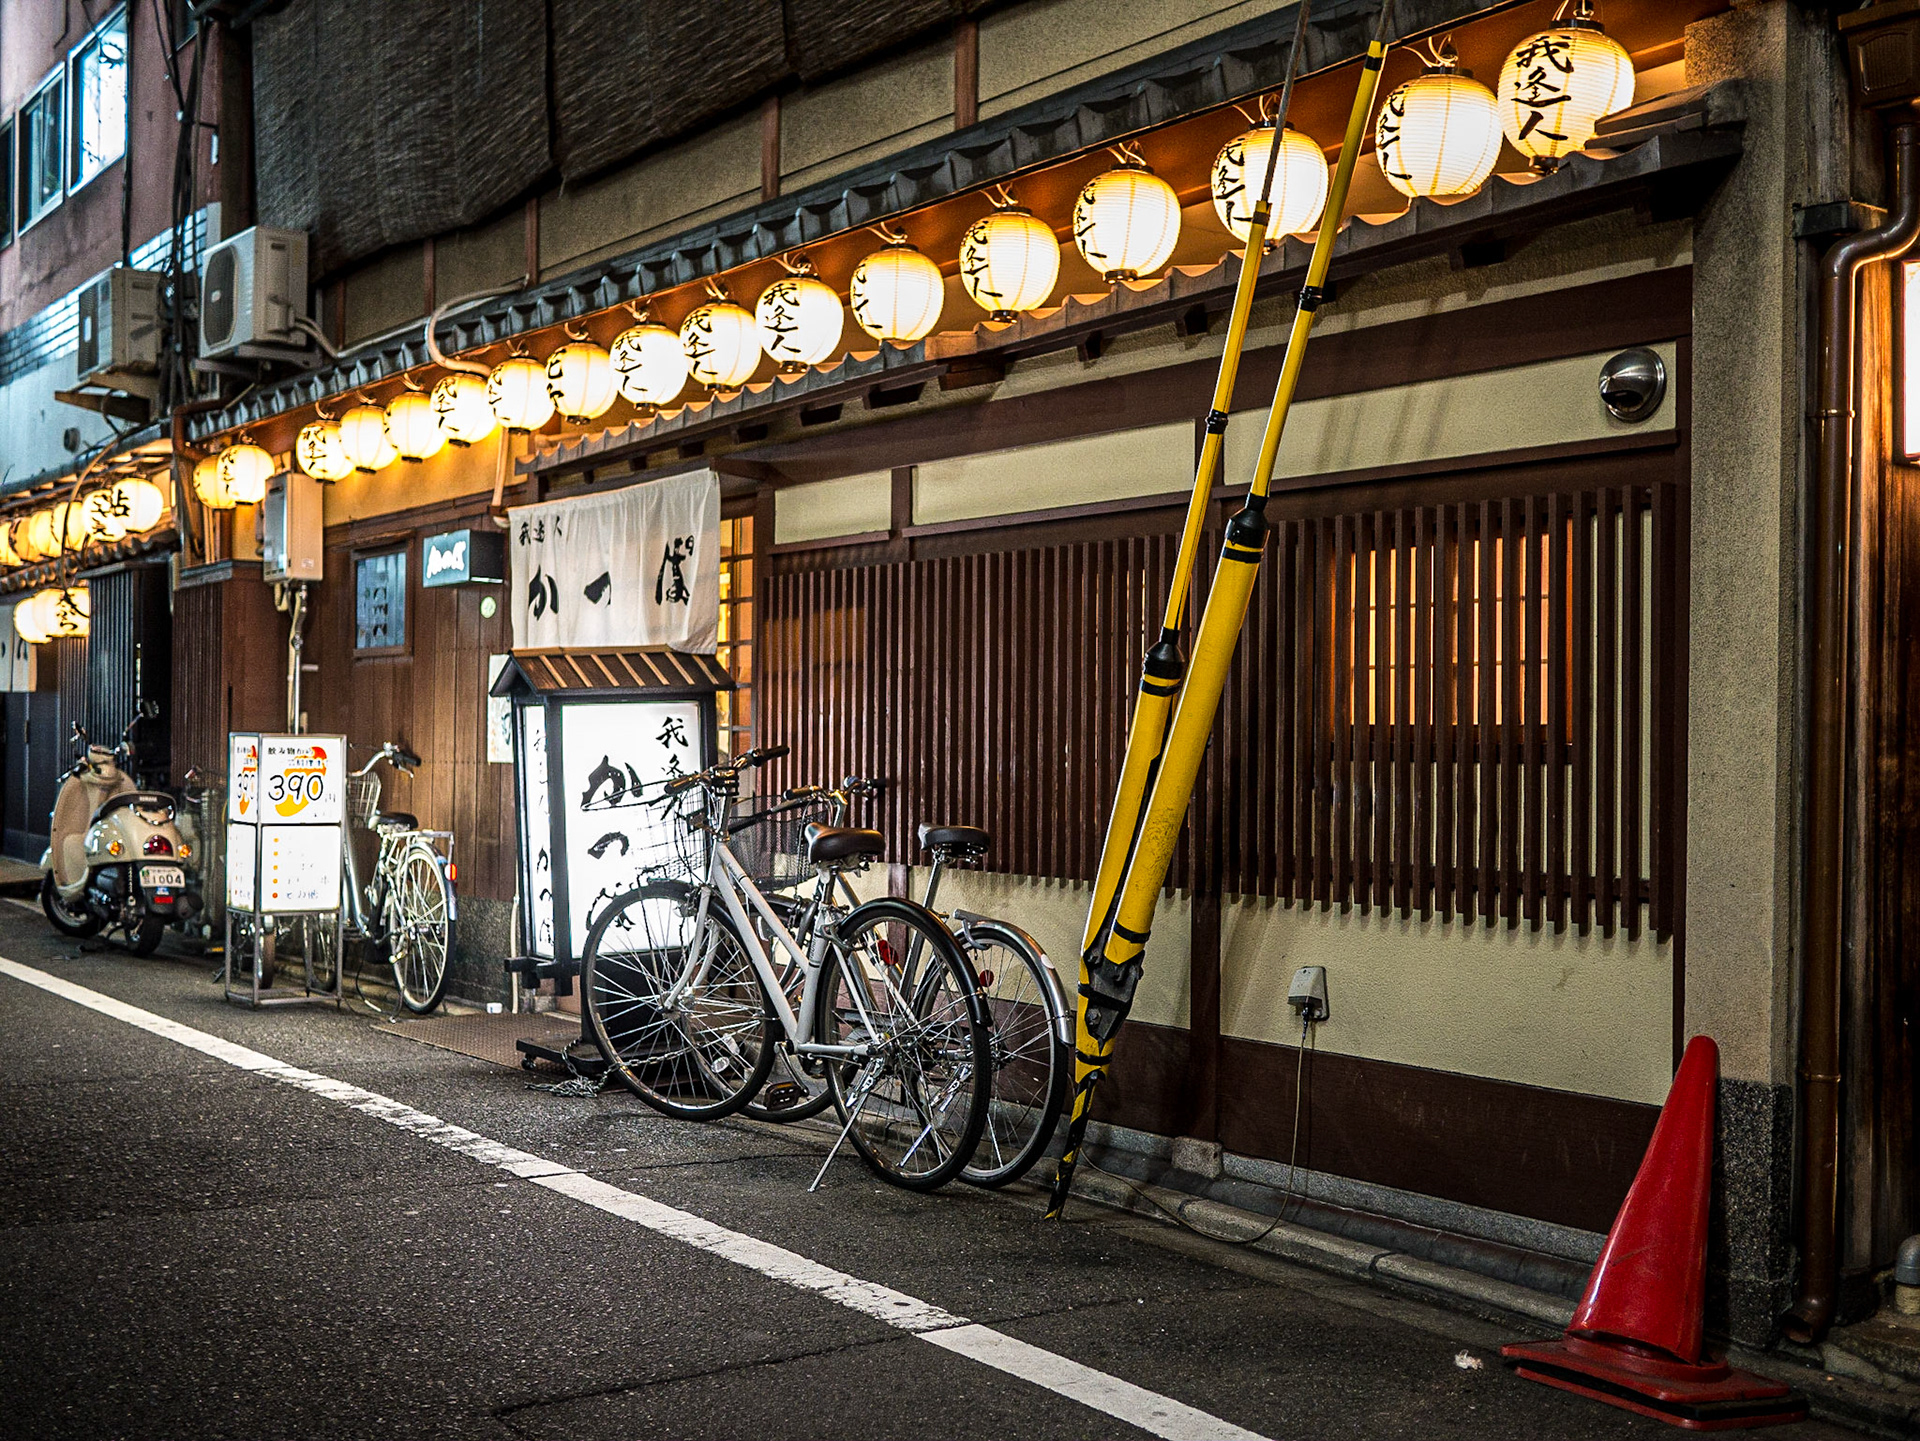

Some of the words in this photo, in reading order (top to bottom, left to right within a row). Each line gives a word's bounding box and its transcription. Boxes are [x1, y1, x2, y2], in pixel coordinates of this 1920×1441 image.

[1515, 36, 1575, 141] 我逢人
[268, 774, 324, 801] 390
